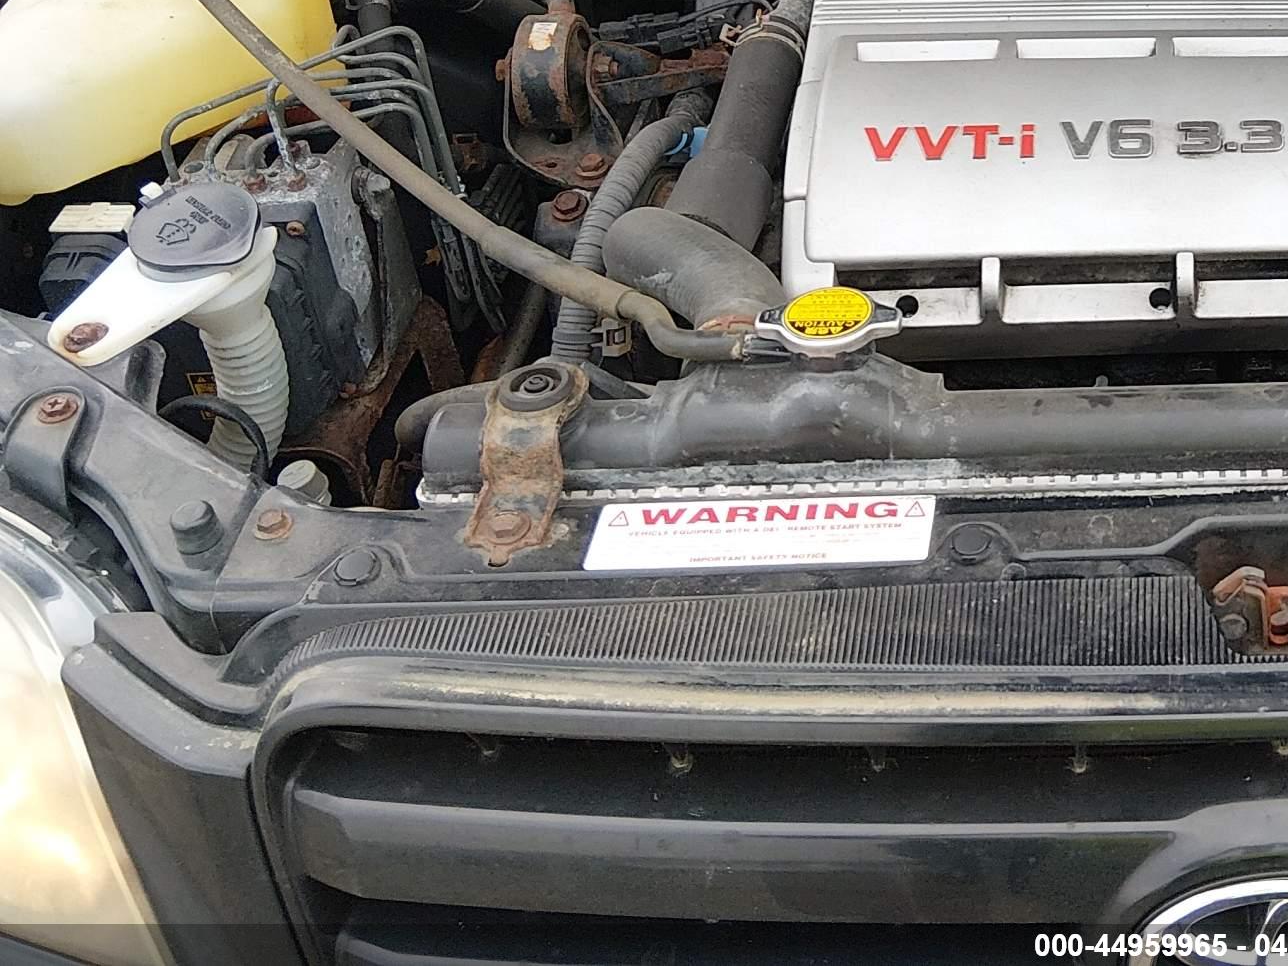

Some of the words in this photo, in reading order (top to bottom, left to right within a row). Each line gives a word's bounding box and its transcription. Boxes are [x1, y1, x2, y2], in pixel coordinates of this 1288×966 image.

[864, 124, 1036, 161] VVT-i
[1059, 119, 1154, 160] V6
[1177, 119, 1288, 157] 3.3
[794, 320, 855, 328] CAUTION
[642, 501, 898, 525] WARNING
